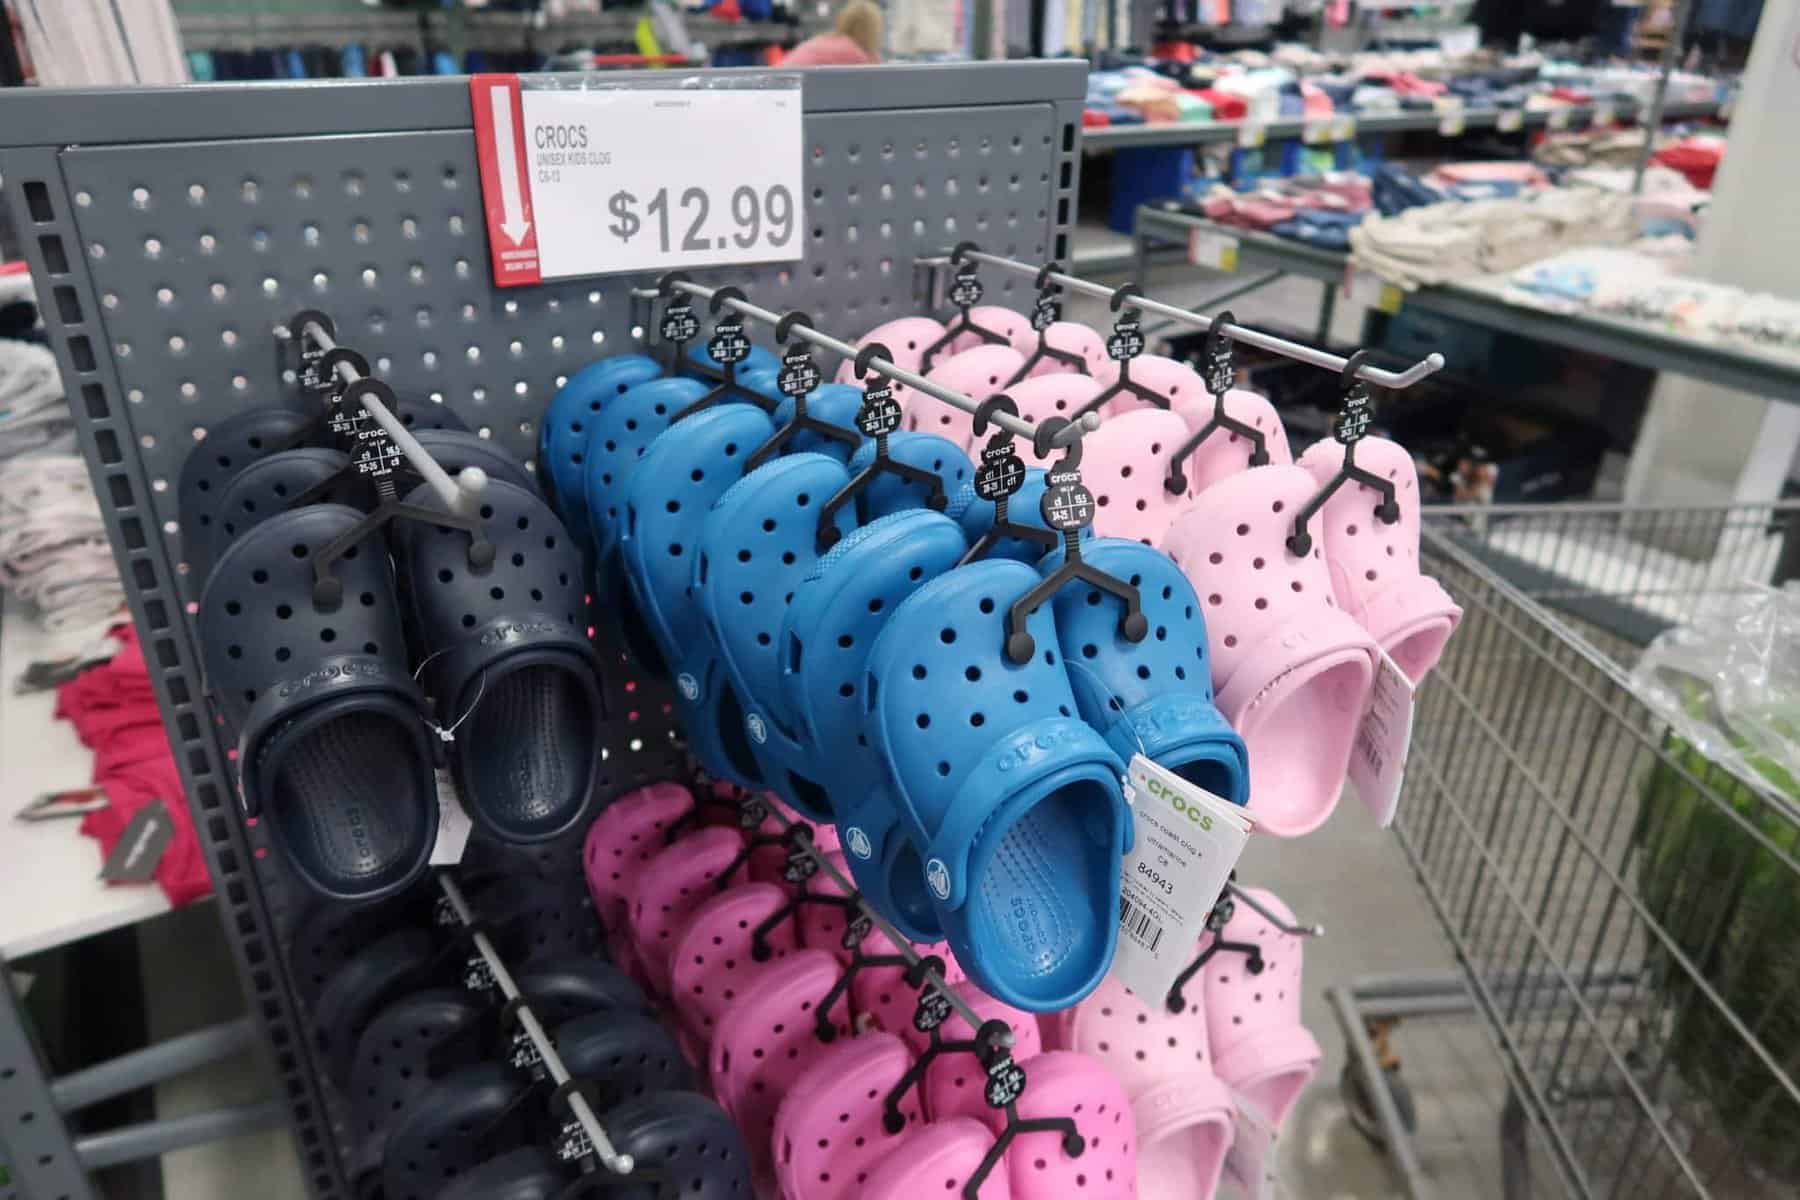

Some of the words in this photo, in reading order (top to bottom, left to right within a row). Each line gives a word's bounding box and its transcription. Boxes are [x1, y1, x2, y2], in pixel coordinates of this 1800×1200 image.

[535, 124, 588, 149] CROCS
[537, 151, 565, 167] UNISEX
[567, 150, 586, 166] KIDS
[588, 150, 611, 166] CLOG
[607, 184, 794, 254] $12.99
[1147, 778, 1214, 832] crocs
[1137, 861, 1174, 895] 84943
